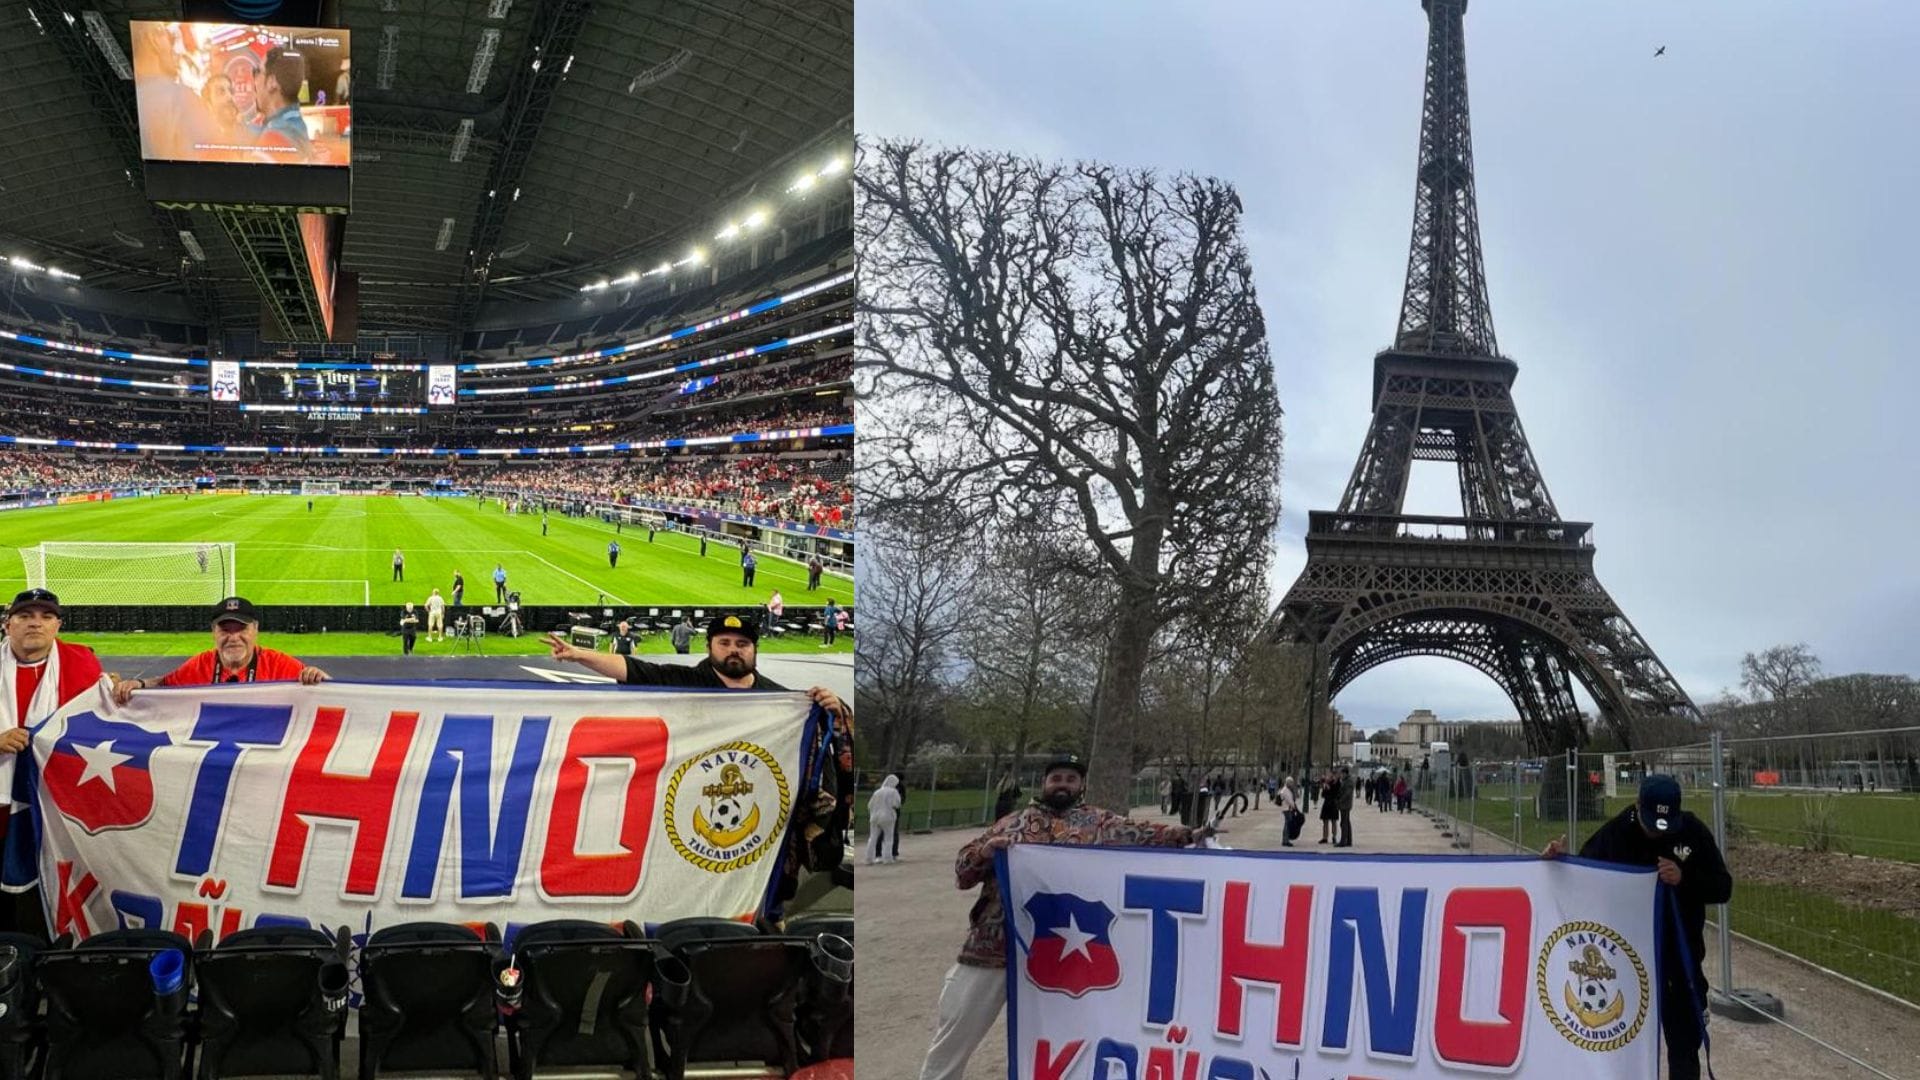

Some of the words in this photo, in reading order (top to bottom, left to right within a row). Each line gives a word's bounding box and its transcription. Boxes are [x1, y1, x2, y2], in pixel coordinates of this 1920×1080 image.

[154, 201, 347, 215] WINSTAR
[327, 412, 362, 421] STADIUM
[700, 751, 760, 773] NAVAL
[176, 702, 669, 898] THNO
[688, 834, 762, 860] TALCAHUANO
[1565, 933, 1617, 956] NAVAL
[1124, 874, 1533, 1068] THNO
[1563, 1013, 1627, 1040] TALCAHUANO
